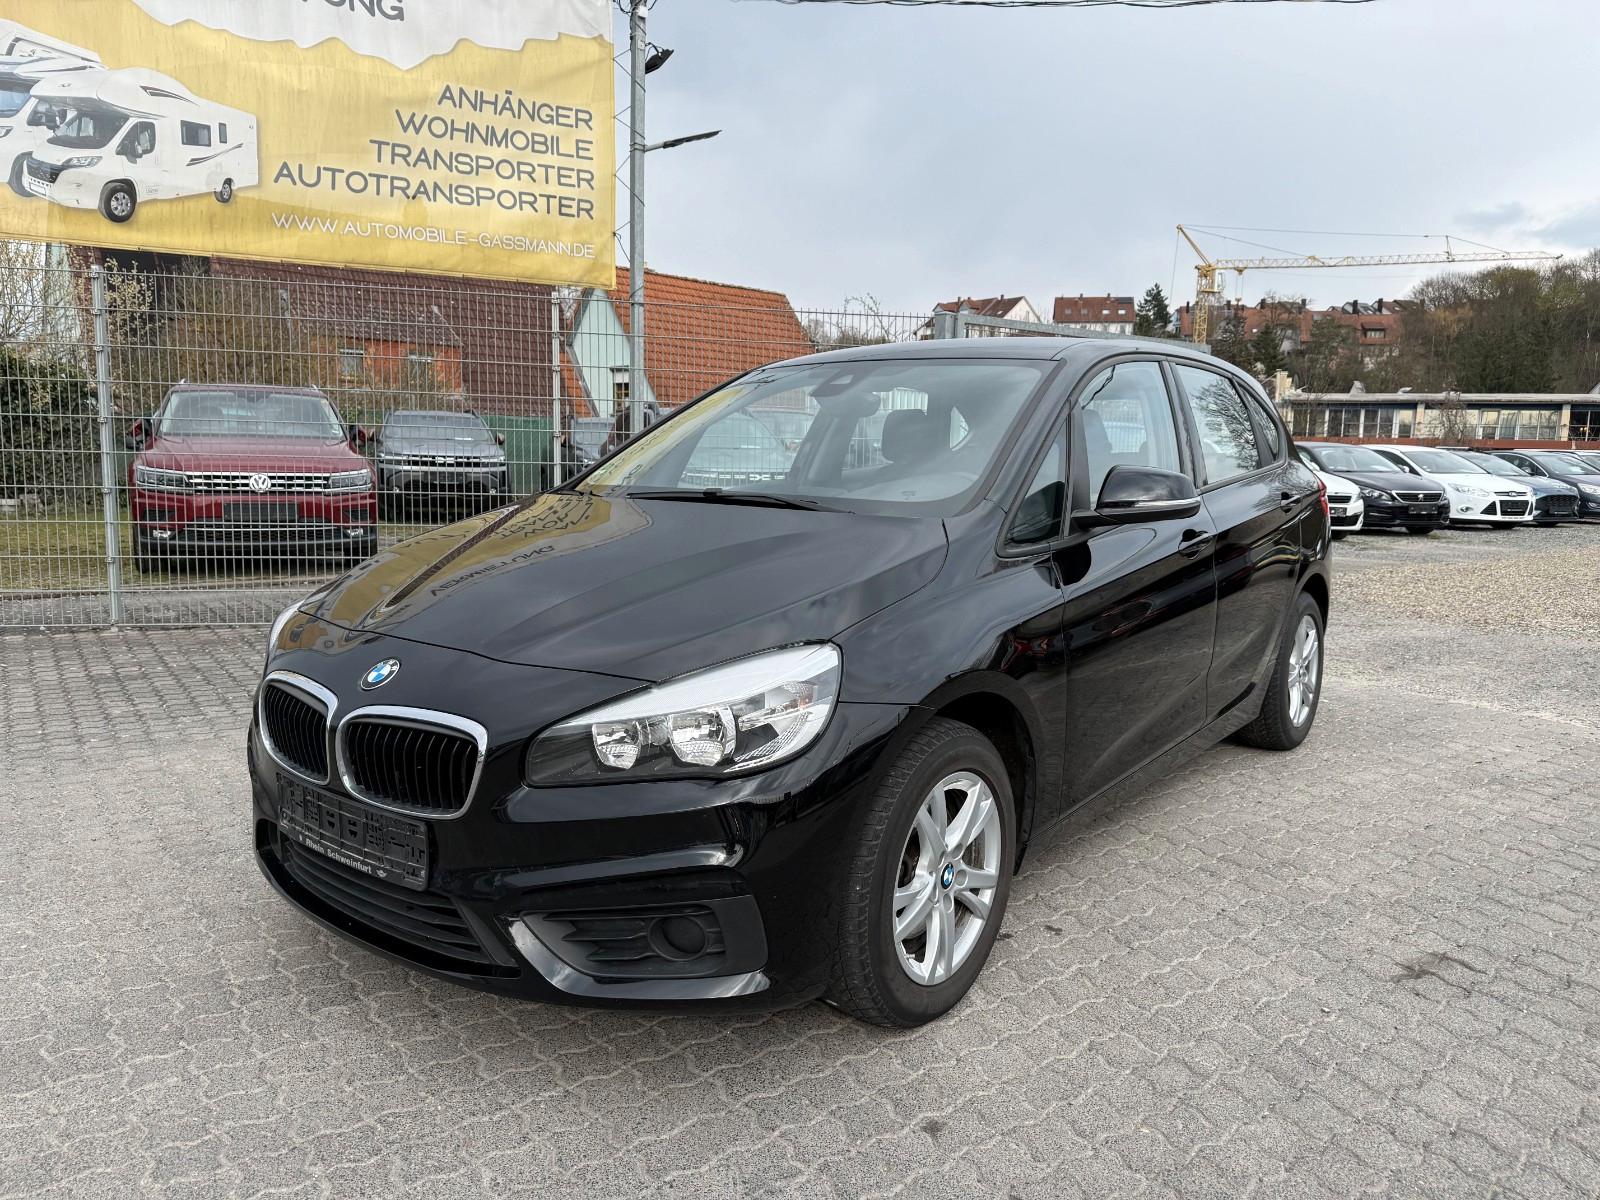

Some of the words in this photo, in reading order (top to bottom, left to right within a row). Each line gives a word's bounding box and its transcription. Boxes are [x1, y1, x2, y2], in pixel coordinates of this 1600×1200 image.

[437, 84, 593, 131] ANHÄNGER
[395, 109, 594, 160] WOHNMOBILE
[369, 139, 595, 191] TRANSPORTER
[273, 161, 594, 220] AUTOTRANSPORTER
[271, 212, 596, 258] WWW.AUTOMOBILE-GASSMANN.DE
[305, 838, 325, 854] Rhein
[327, 848, 372, 874] Schweinfurt
